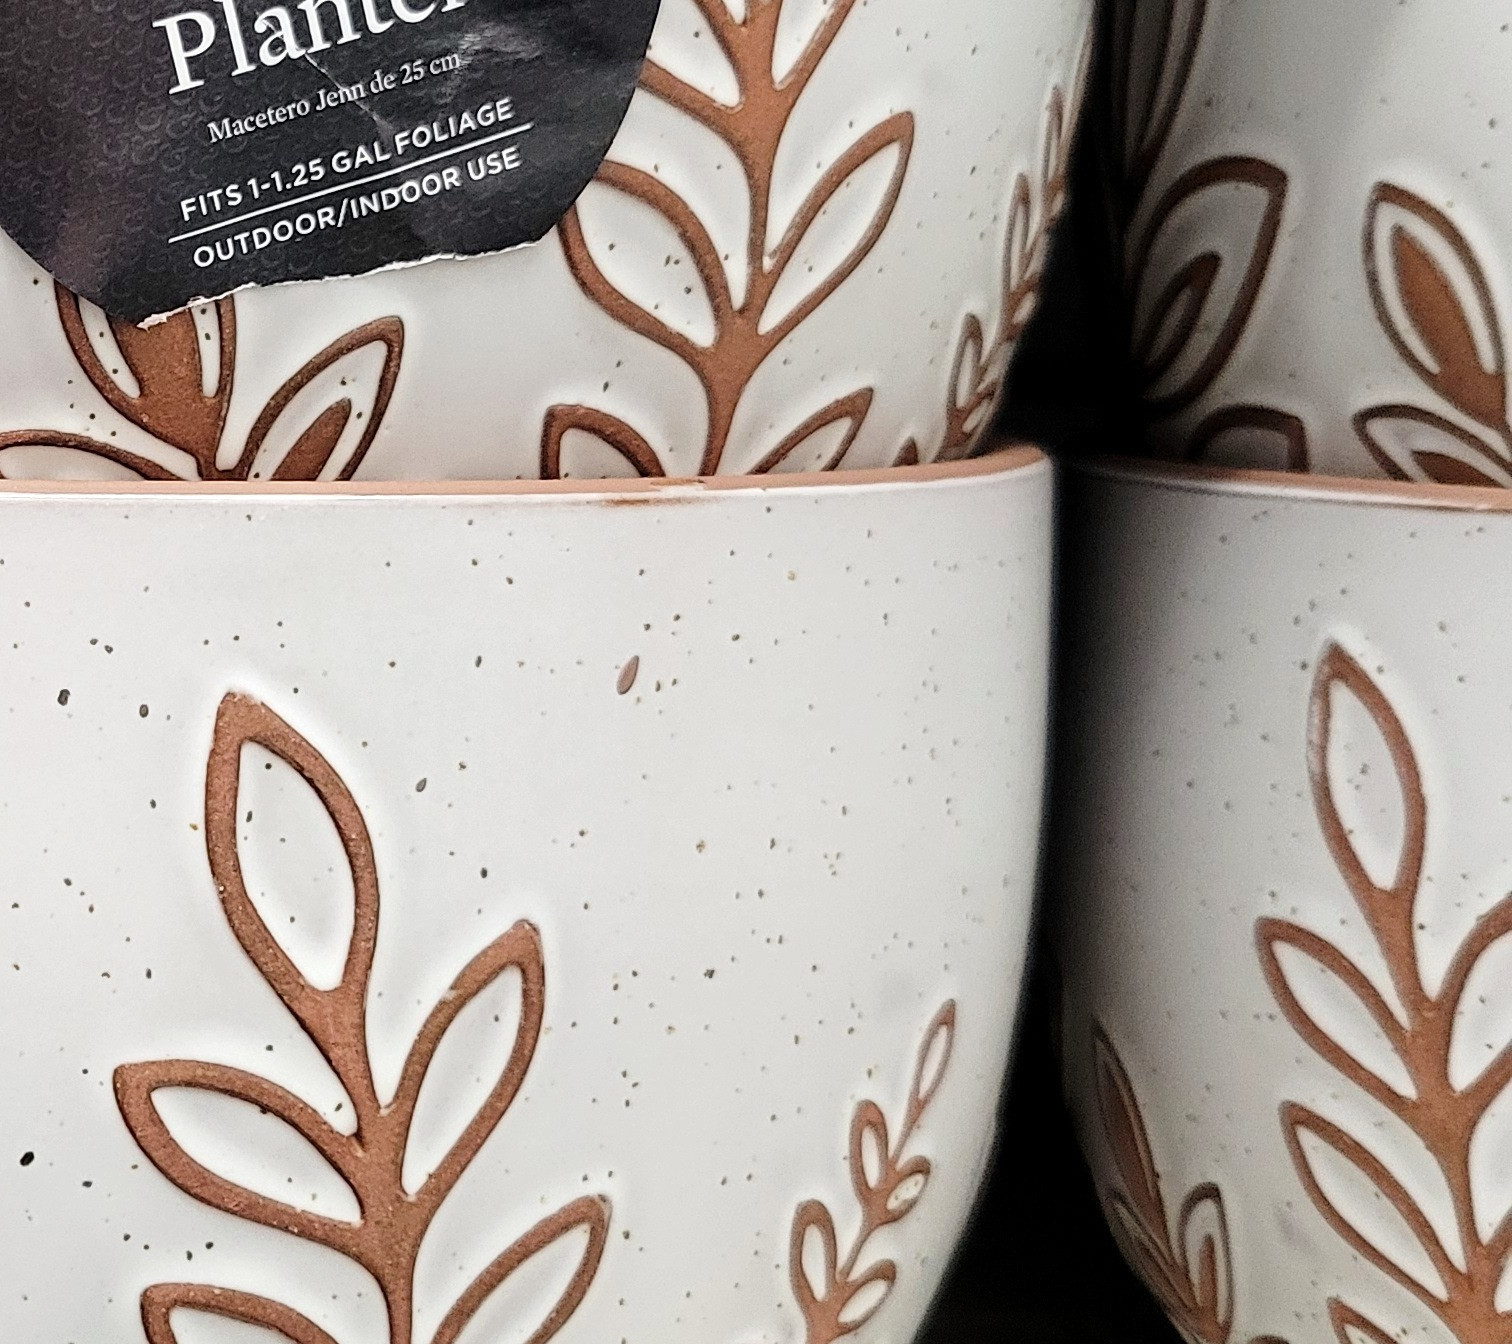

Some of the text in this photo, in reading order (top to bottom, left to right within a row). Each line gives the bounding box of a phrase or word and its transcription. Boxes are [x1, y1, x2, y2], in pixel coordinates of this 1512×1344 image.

[207, 53, 460, 143] Macetero Jenn de 25 cm
[180, 97, 513, 222] FITS 1-1.25 GAL FOLIAGE
[193, 146, 521, 268] OUTDOOR/INDOOR USE
